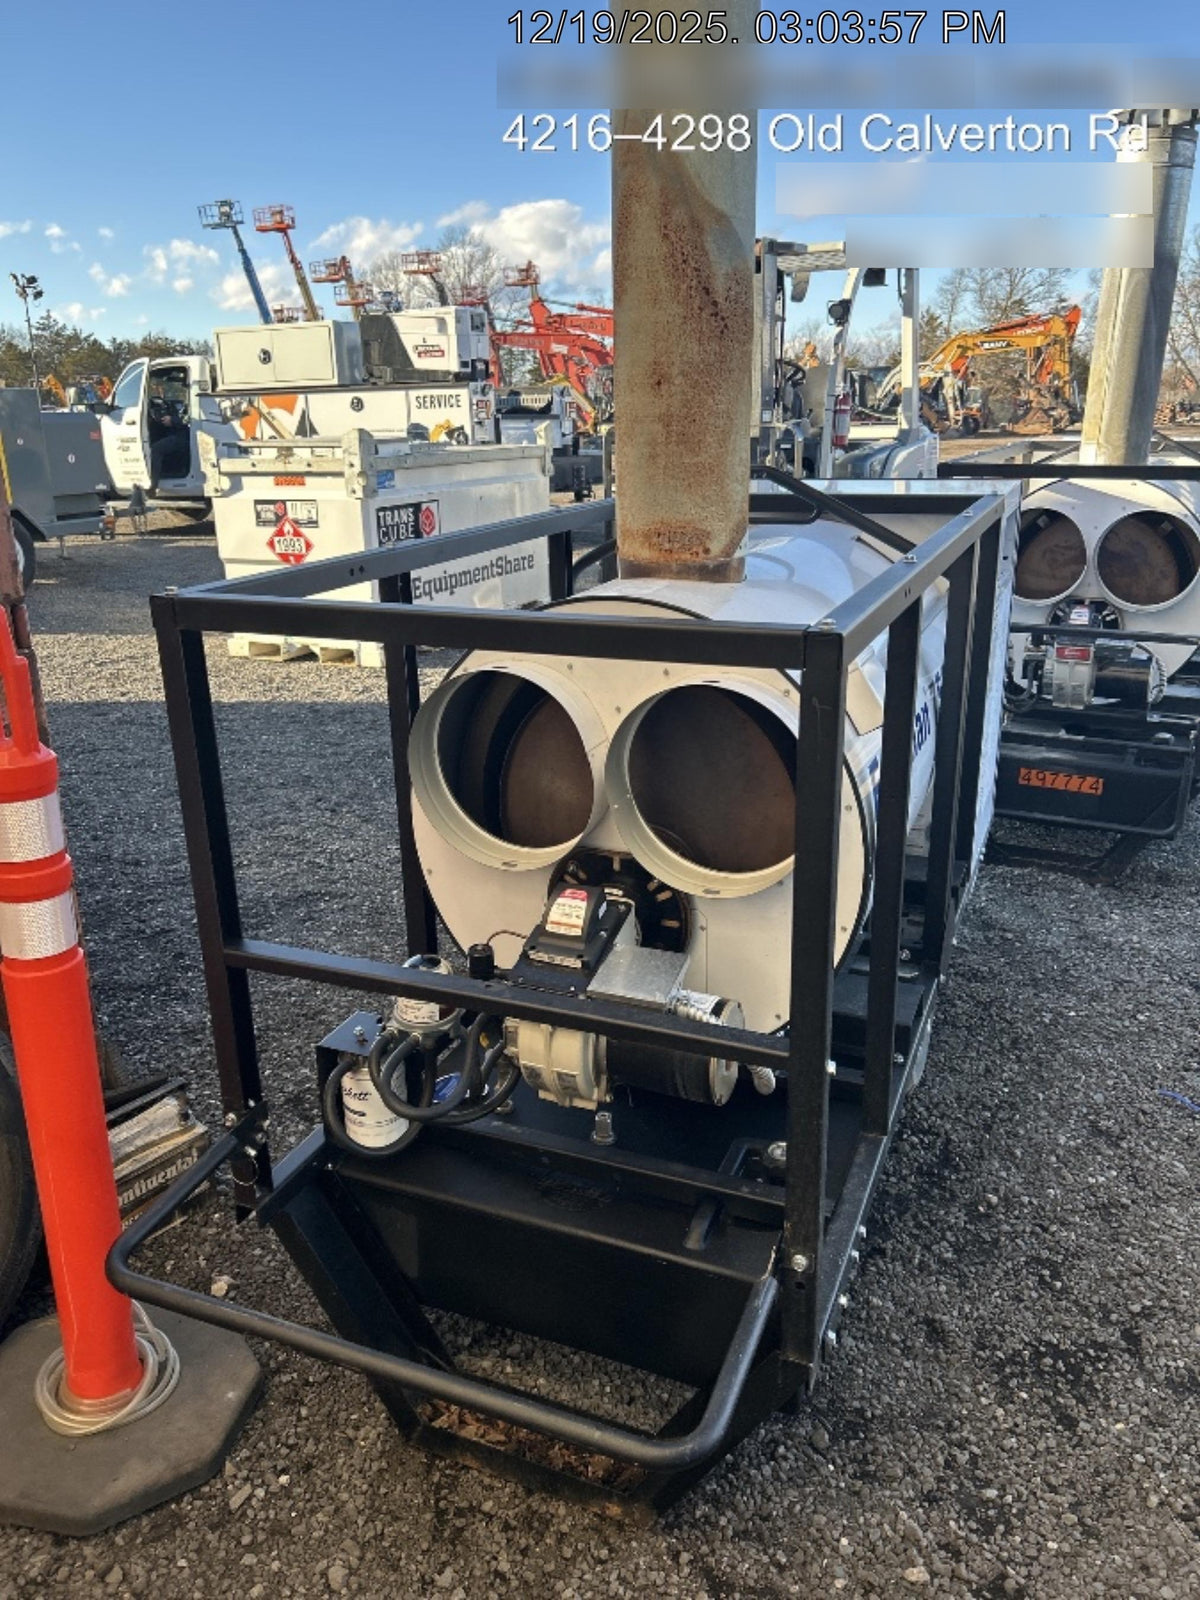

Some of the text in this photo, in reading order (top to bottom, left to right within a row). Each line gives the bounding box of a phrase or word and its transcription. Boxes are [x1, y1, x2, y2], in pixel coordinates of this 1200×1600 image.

[415, 394, 462, 410] SERVICE
[378, 507, 415, 527] TRANS
[380, 521, 416, 542] CUBE
[276, 537, 303, 553] 1993
[412, 553, 535, 602] EquipmentShare
[1021, 768, 1101, 794] 497774
